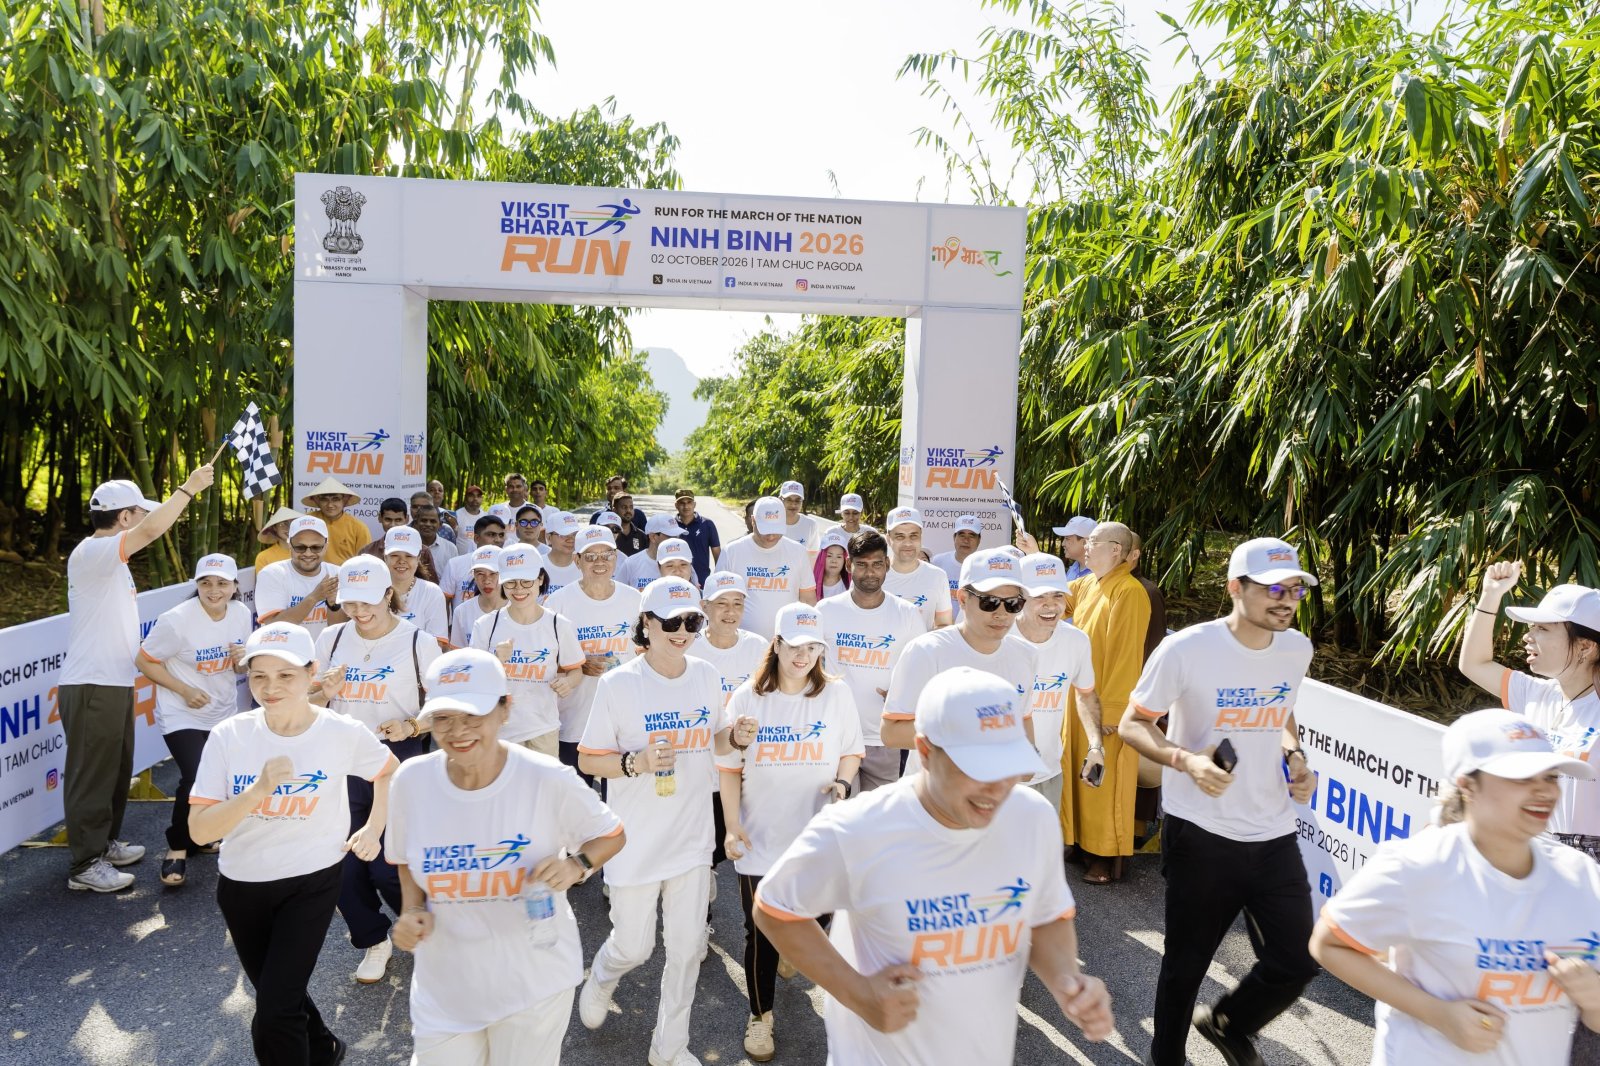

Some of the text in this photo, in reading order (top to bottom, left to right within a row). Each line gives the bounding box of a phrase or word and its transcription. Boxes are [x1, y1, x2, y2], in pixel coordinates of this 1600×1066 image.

[501, 202, 570, 219] VIKSIT
[654, 206, 862, 224] RUN FOR THE MARCH OF THE NATION
[501, 218, 588, 236] BHARAT
[651, 226, 864, 255] NINH BINH 2026
[500, 236, 632, 276] RUN
[651, 254, 664, 264] 02
[667, 255, 718, 265] OCTOBER
[722, 257, 748, 267] 2026
[757, 259, 780, 268] TAM
[782, 260, 814, 269] CHUC
[817, 262, 863, 272] PAGODA
[307, 431, 347, 441] VIKSIT
[307, 441, 358, 451] BHARAT
[928, 448, 965, 457] VIKSIT
[307, 452, 384, 475] RUN
[927, 458, 974, 467] BHARAT
[926, 468, 997, 489] RUN
[354, 509, 380, 517] PAGO
[748, 577, 788, 590] RUN
[577, 626, 604, 634] VIKSIT
[577, 632, 612, 640] BHARAT
[836, 633, 865, 641] VIKSIT
[196, 646, 222, 655] VIKSIT
[581, 638, 628, 653] RUN
[836, 640, 873, 649] BHARAT
[196, 652, 228, 661] BHARAT
[838, 647, 890, 666] RUN
[24, 661, 38, 679] OF
[41, 652, 61, 673] THE
[1216, 688, 1256, 697] VIKSIT
[1216, 698, 1266, 707] BHARAT
[1, 694, 40, 745] NH
[645, 712, 680, 722] VIKSIT
[1215, 707, 1287, 728] RUN
[645, 720, 691, 732] BHARAT
[757, 734, 802, 742] BHARAT
[5, 734, 63, 772] TAM CHUC
[756, 742, 823, 762] RUN
[1308, 728, 1331, 754] THE
[1334, 740, 1388, 779] MARCH
[1392, 765, 1413, 788] OF
[1418, 774, 1439, 798] TH
[234, 775, 256, 784] VIK
[2, 788, 34, 810] IN VIETNAM
[1326, 777, 1411, 845] BINH
[424, 844, 475, 859] VIKSIT
[1318, 830, 1348, 862] 2026
[423, 857, 490, 873] BHARAT
[428, 867, 526, 898] RUN
[906, 893, 970, 914] VIKSIT
[908, 908, 989, 931] BHARAT
[911, 920, 1024, 967] RUN
